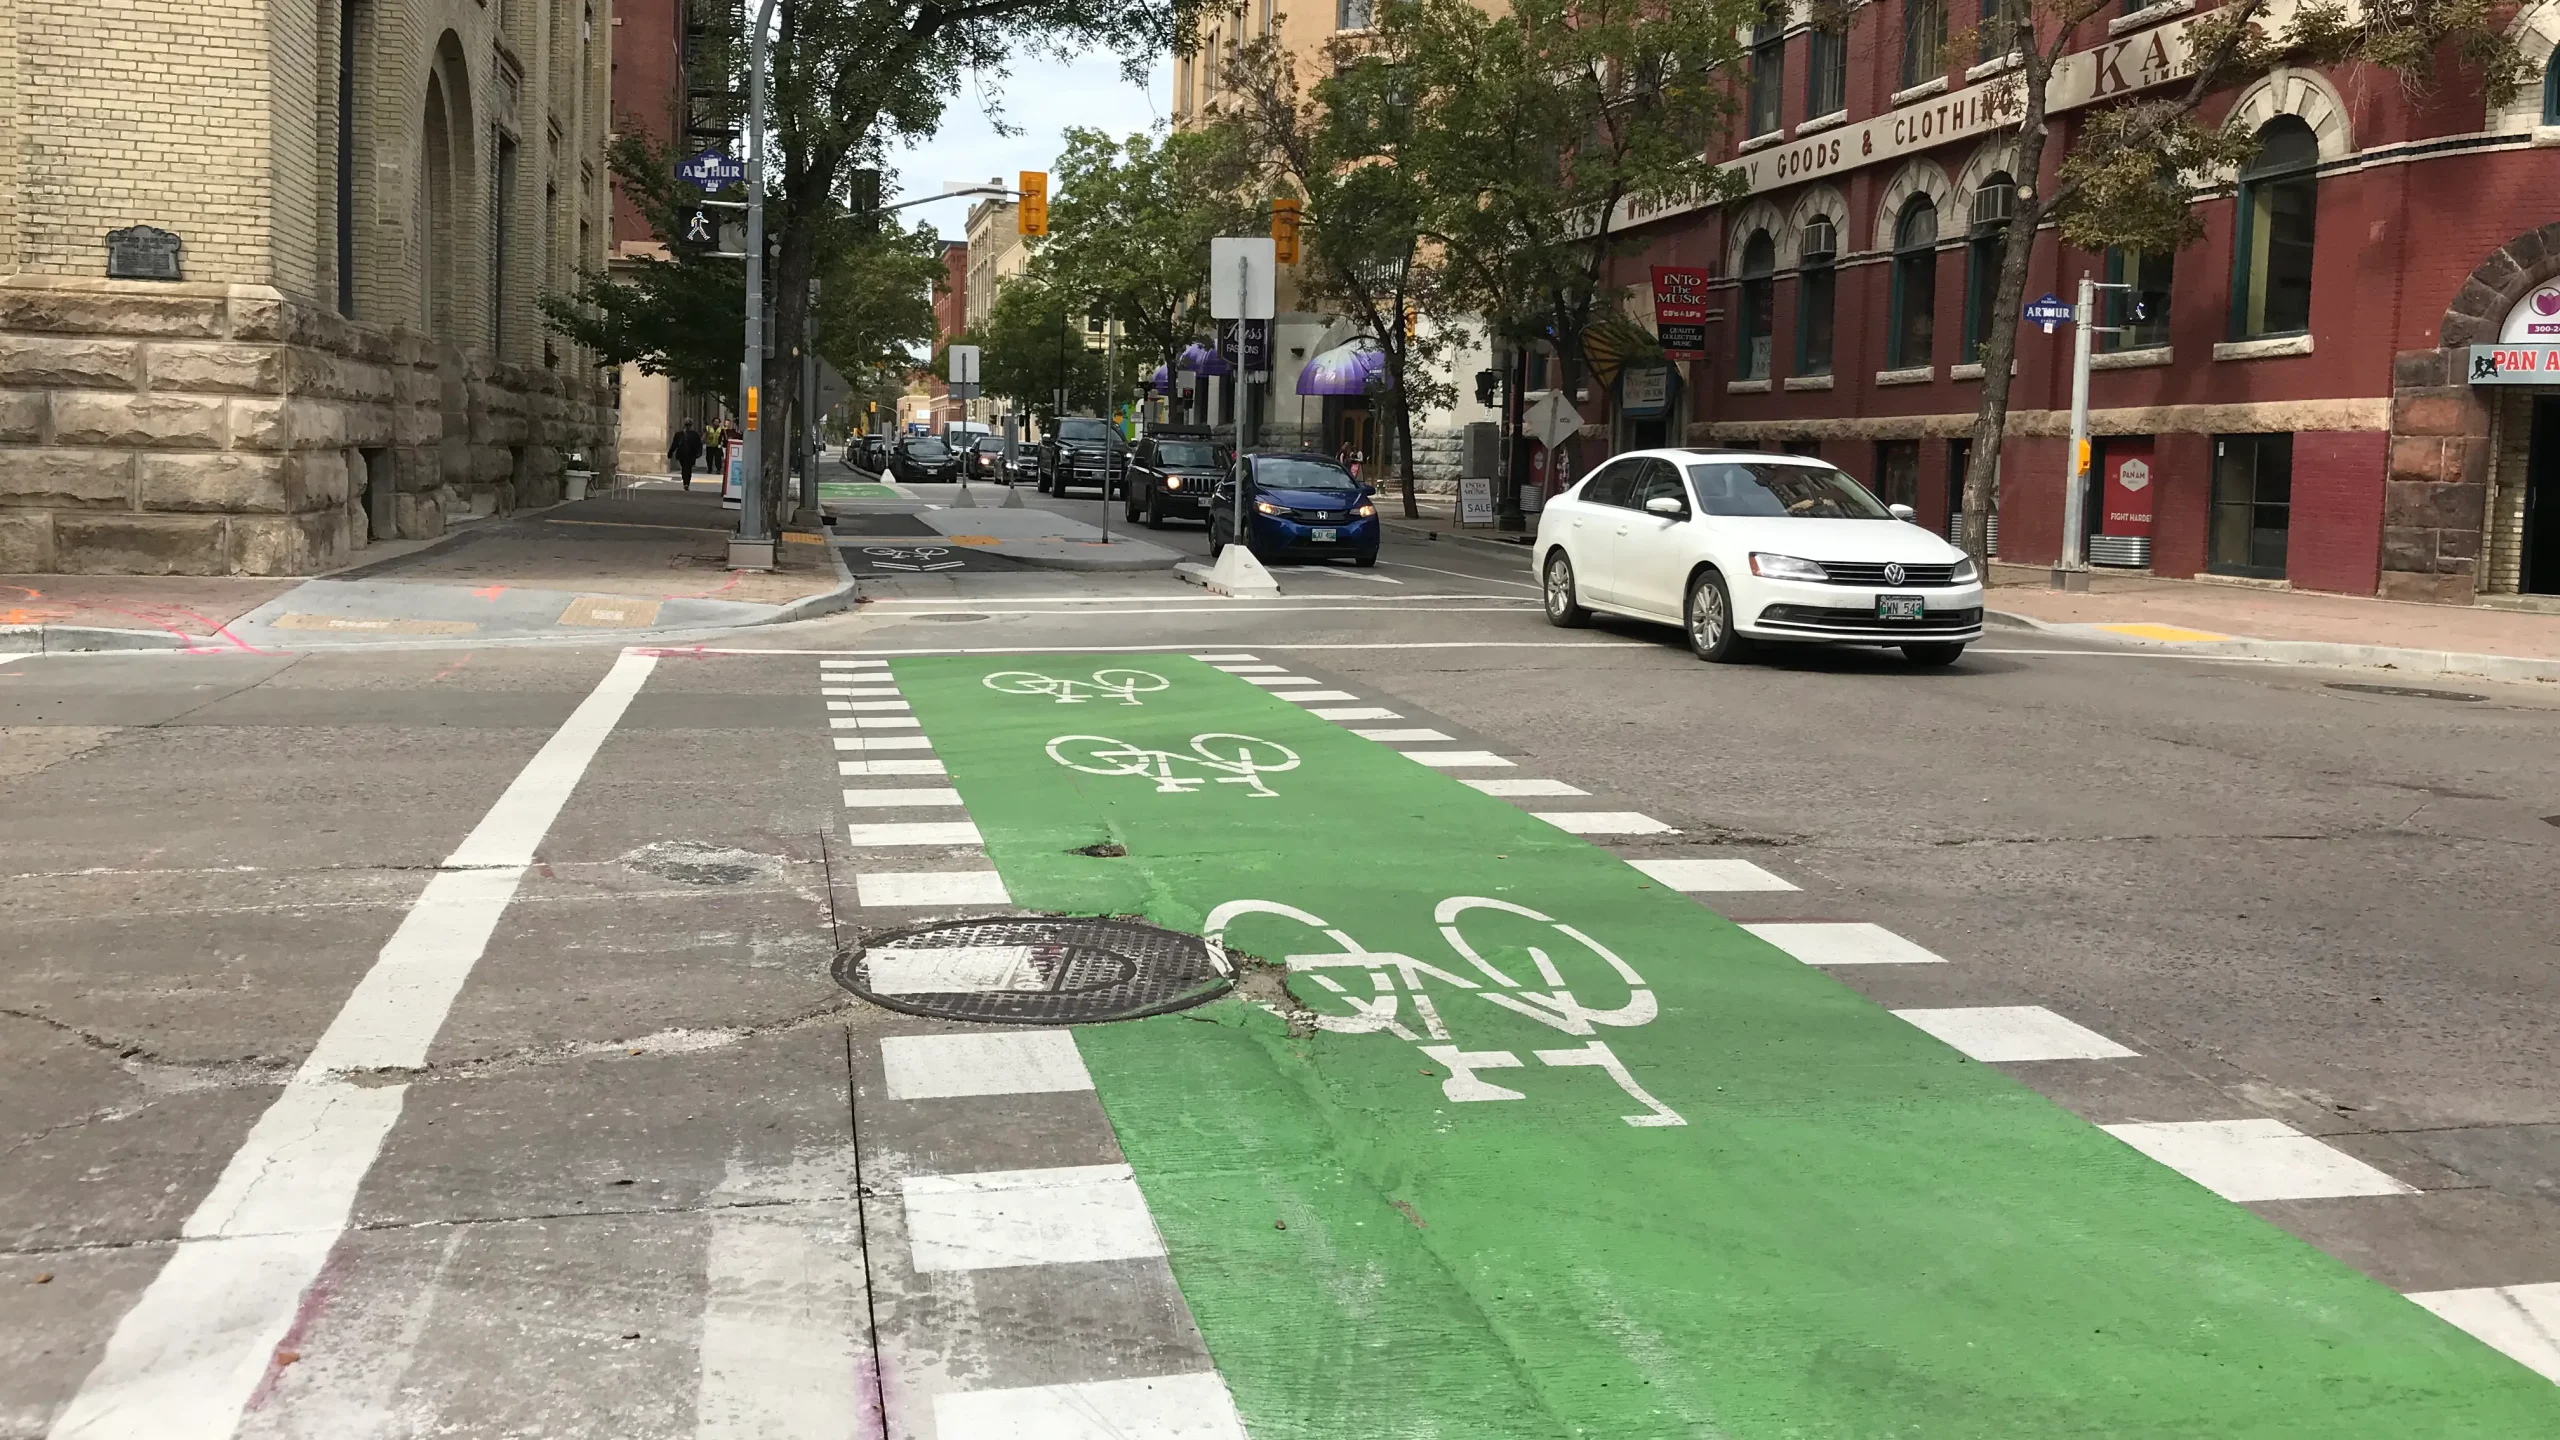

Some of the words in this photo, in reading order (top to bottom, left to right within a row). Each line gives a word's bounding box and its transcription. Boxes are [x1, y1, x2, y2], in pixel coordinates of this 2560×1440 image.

[1777, 139, 1840, 179] GOODS
[1862, 129, 1872, 157] &
[1895, 83, 2014, 146] CLOTHING
[1664, 273, 1701, 286] INTO
[1670, 285, 1691, 294] The
[1656, 293, 1707, 305] MUSIC
[1669, 327, 1697, 335] QUALITY
[2534, 325, 2560, 333] 300-2
[1662, 333, 1703, 342] COLLECTIBLE
[1226, 343, 1259, 355] FASONS
[2492, 350, 2537, 371] PAN
[1467, 503, 1492, 512] SALE
[2110, 512, 2129, 521] FIGHT
[1881, 601, 1899, 615] GWN
[1903, 602, 1921, 615] 543
